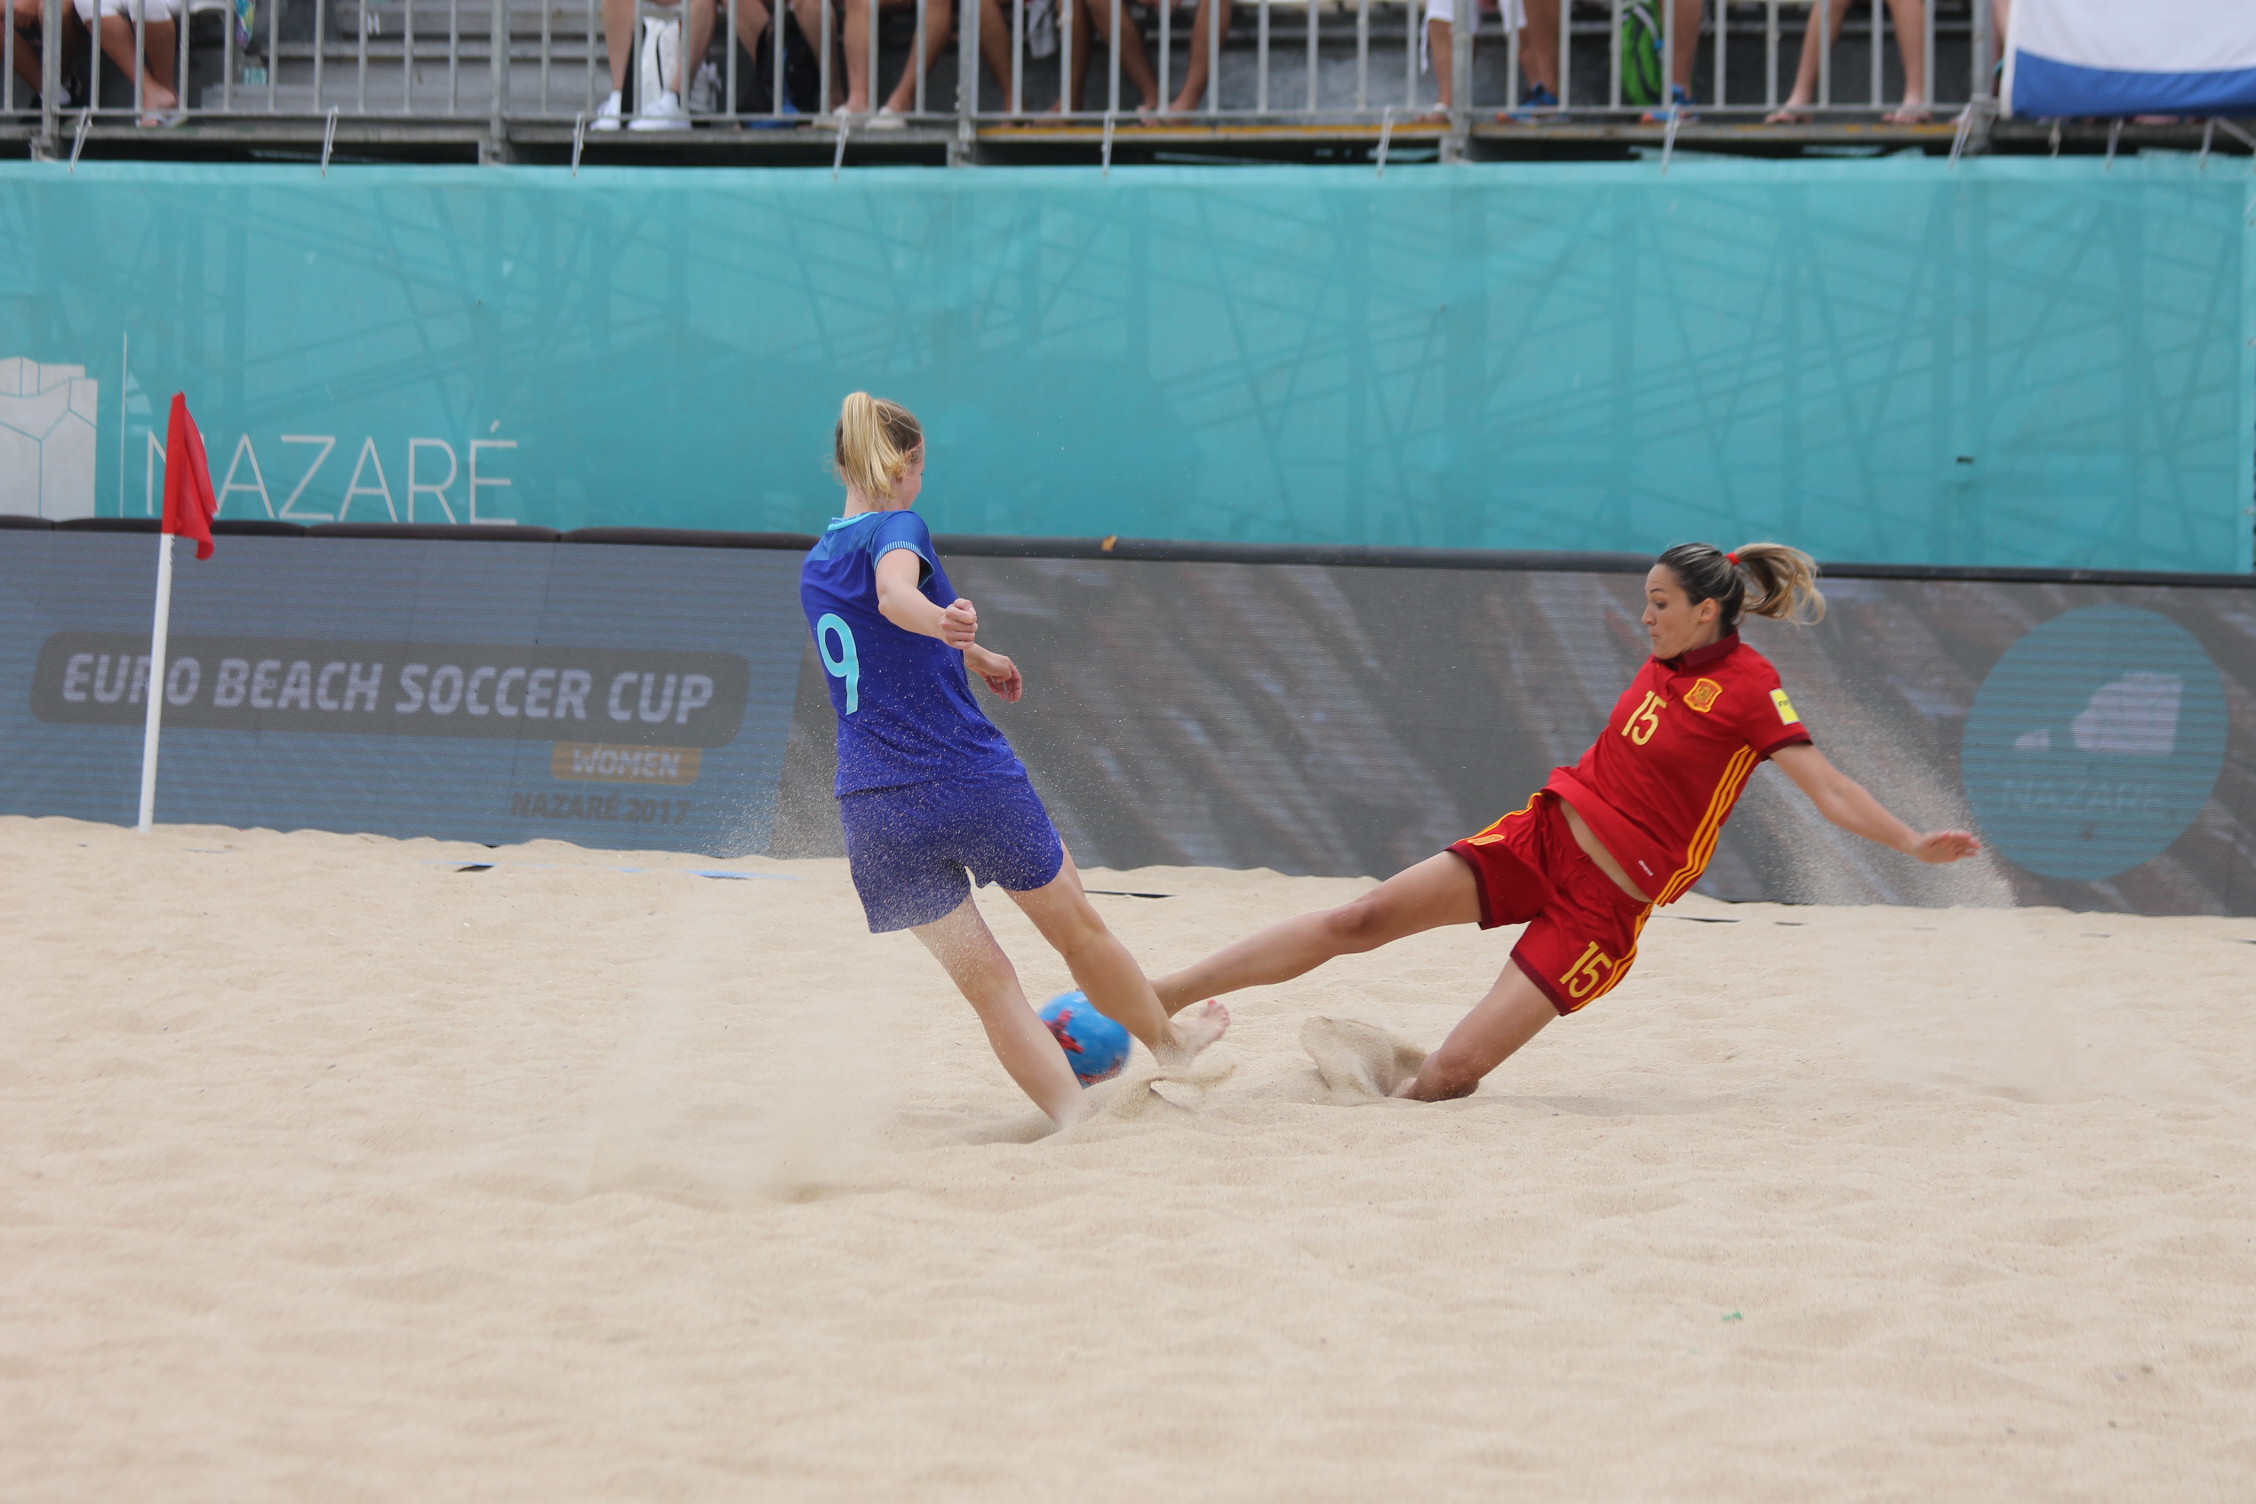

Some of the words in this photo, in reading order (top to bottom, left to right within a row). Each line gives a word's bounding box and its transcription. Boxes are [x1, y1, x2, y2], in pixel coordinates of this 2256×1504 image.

[63, 653, 201, 705] EURO
[213, 658, 384, 712] BEACH
[394, 663, 592, 720] SOCCER
[606, 672, 714, 724] CUP
[817, 612, 859, 715] 9
[1621, 690, 1667, 746] 15
[572, 749, 682, 778] WOMEN
[623, 799, 691, 824] 2017
[1560, 940, 1613, 999] 15
